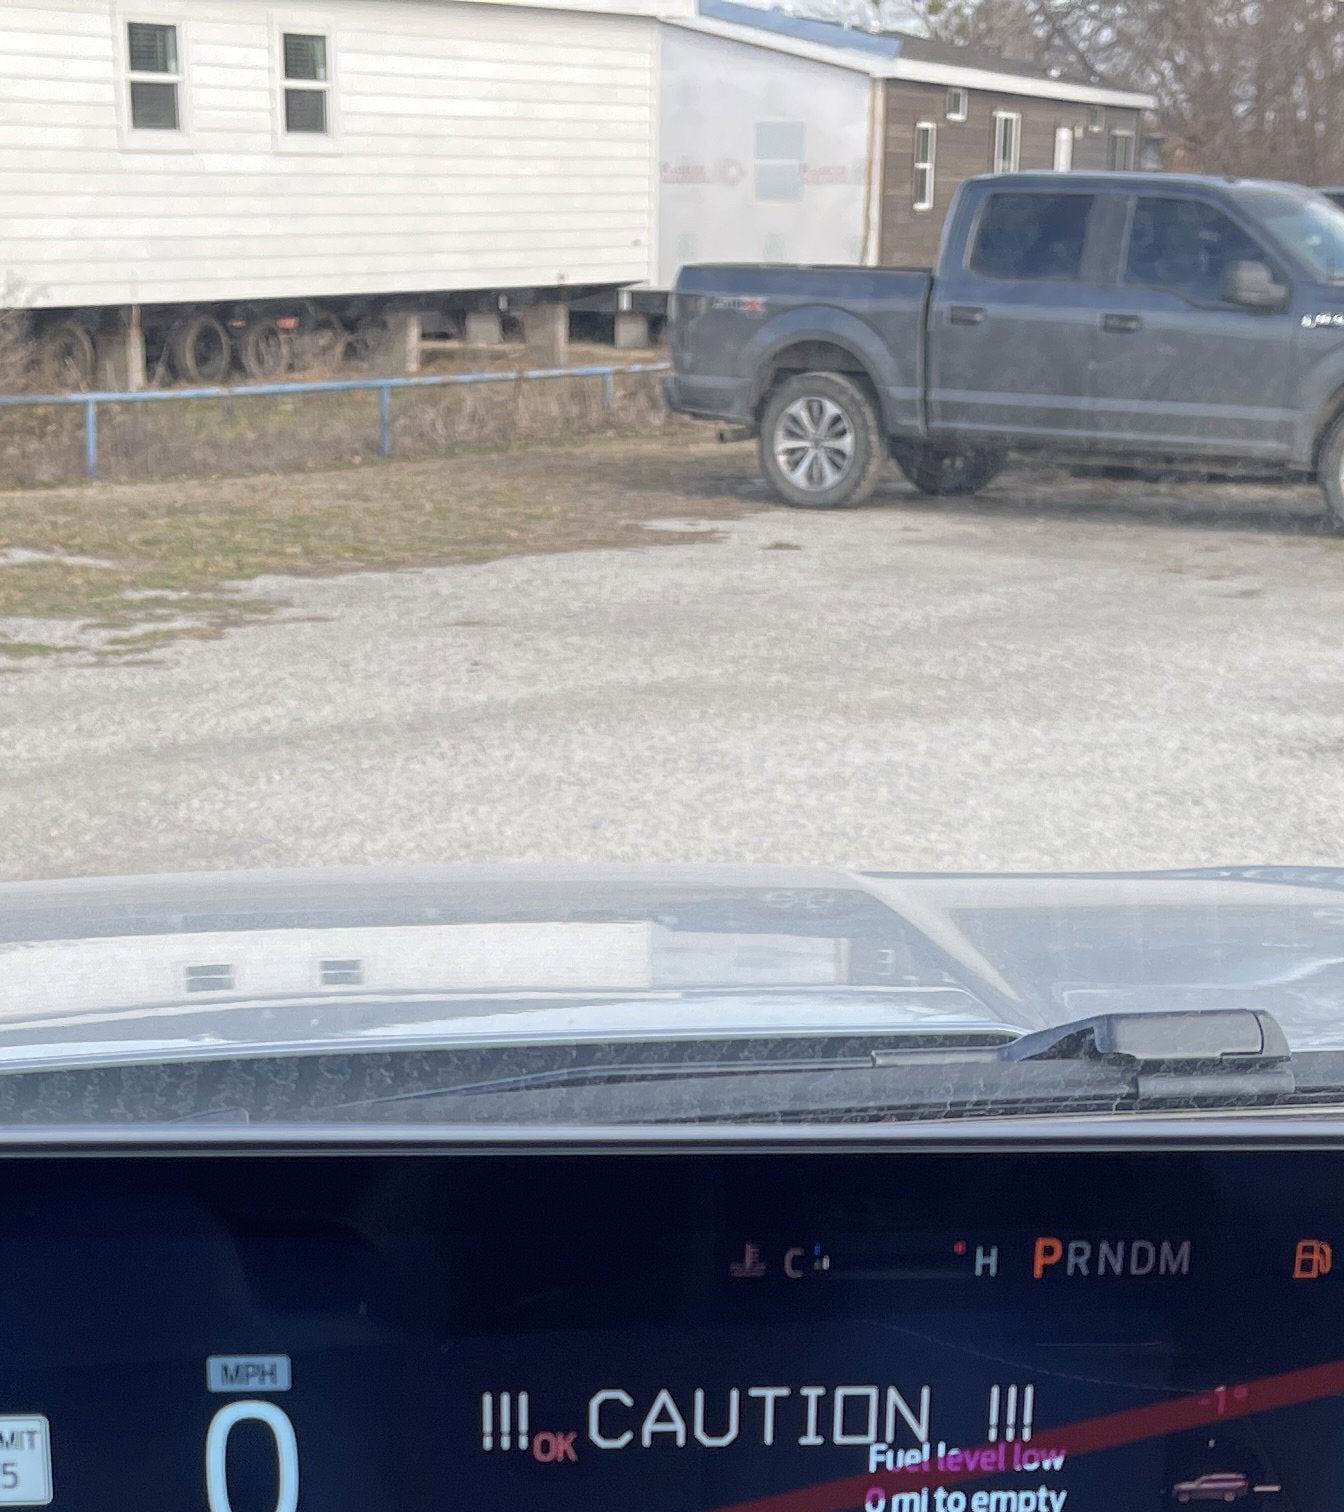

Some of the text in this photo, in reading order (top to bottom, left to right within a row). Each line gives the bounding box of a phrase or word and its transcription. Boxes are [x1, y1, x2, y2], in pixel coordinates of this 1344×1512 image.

[783, 1247, 806, 1279] C
[974, 1245, 998, 1277] H
[220, 1363, 278, 1385] MPH
[588, 1385, 930, 1449] CAUTION
[532, 1430, 578, 1463] OK
[868, 1440, 1067, 1474] Fuel level low
[0, 1461, 19, 1490] 5
